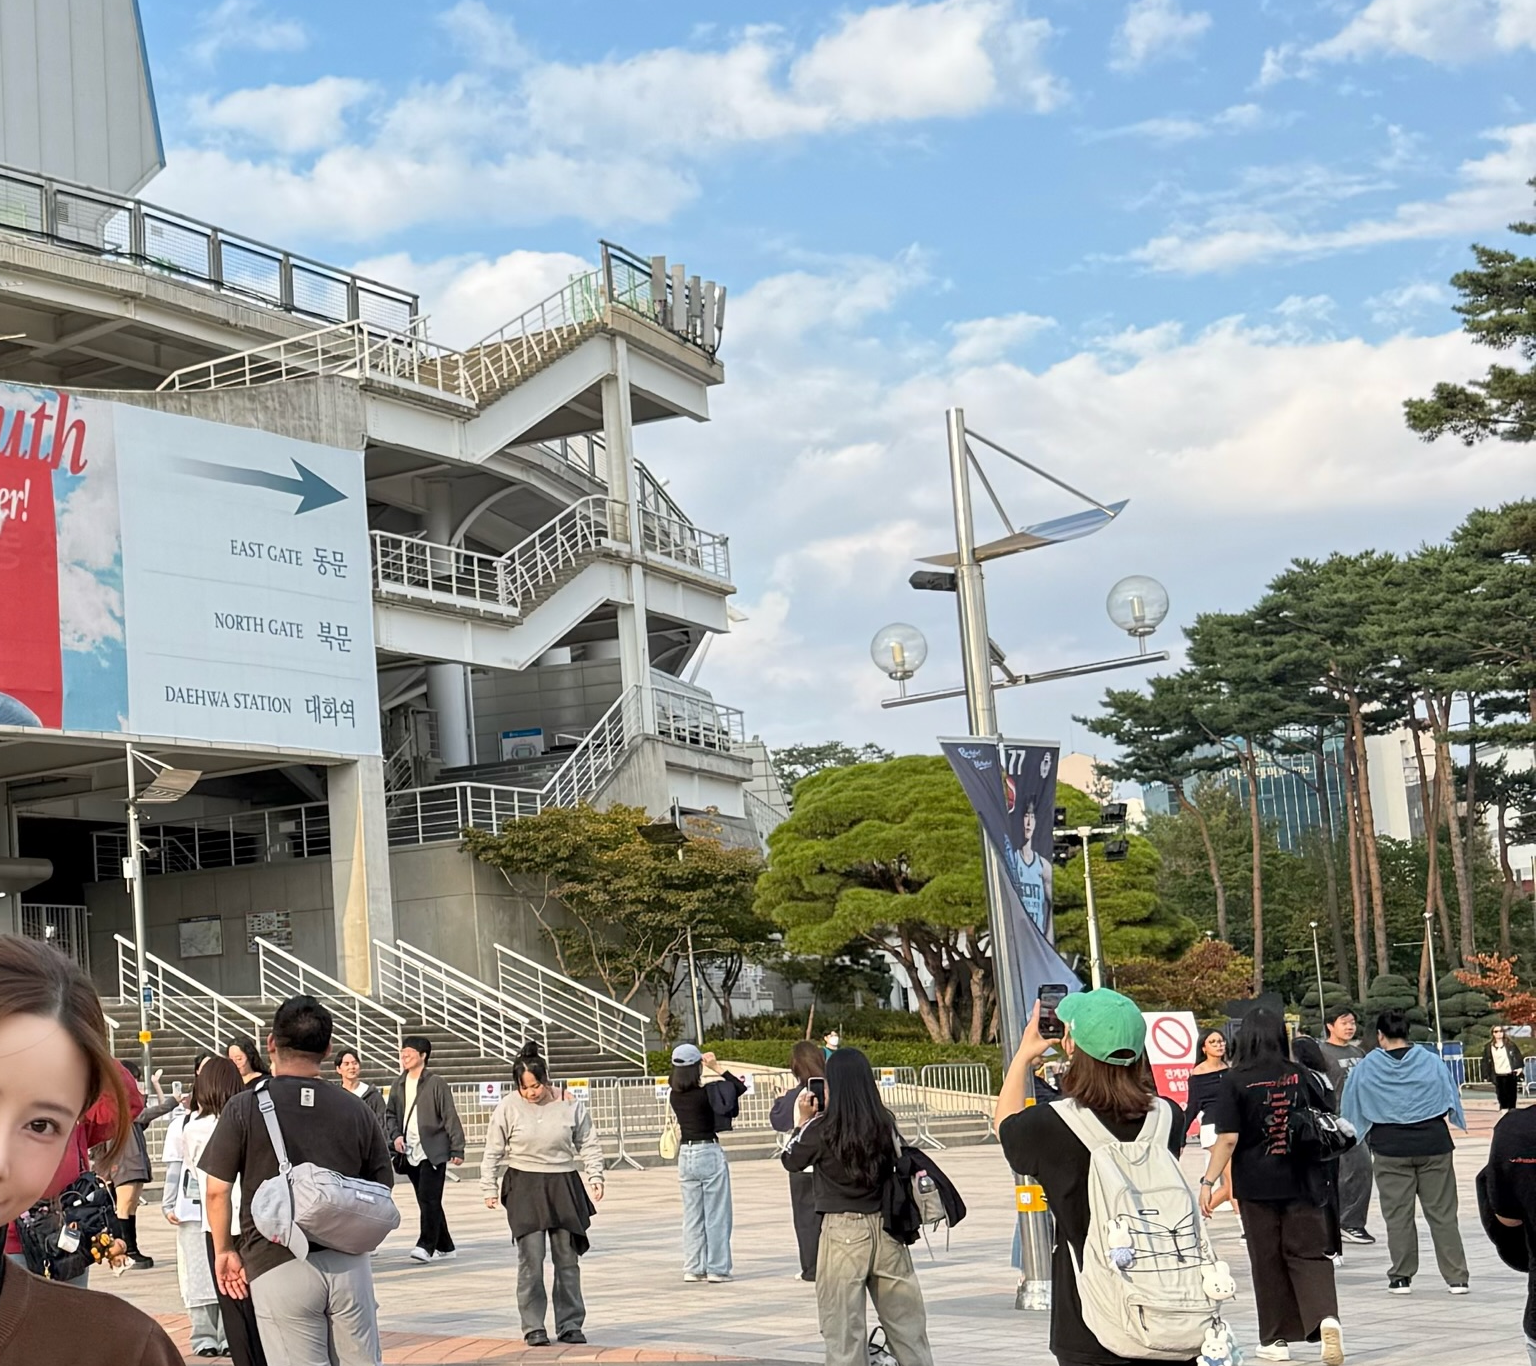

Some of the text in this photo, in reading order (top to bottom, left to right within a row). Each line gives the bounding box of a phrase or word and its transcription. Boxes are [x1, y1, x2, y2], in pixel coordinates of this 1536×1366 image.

[230, 539, 303, 567] EAST GATE
[313, 547, 348, 579] 동문
[214, 612, 304, 639] NORTH GATE
[317, 621, 352, 653] 북문
[165, 685, 292, 715] DAEHWA STATION
[305, 694, 355, 729] 대화역
